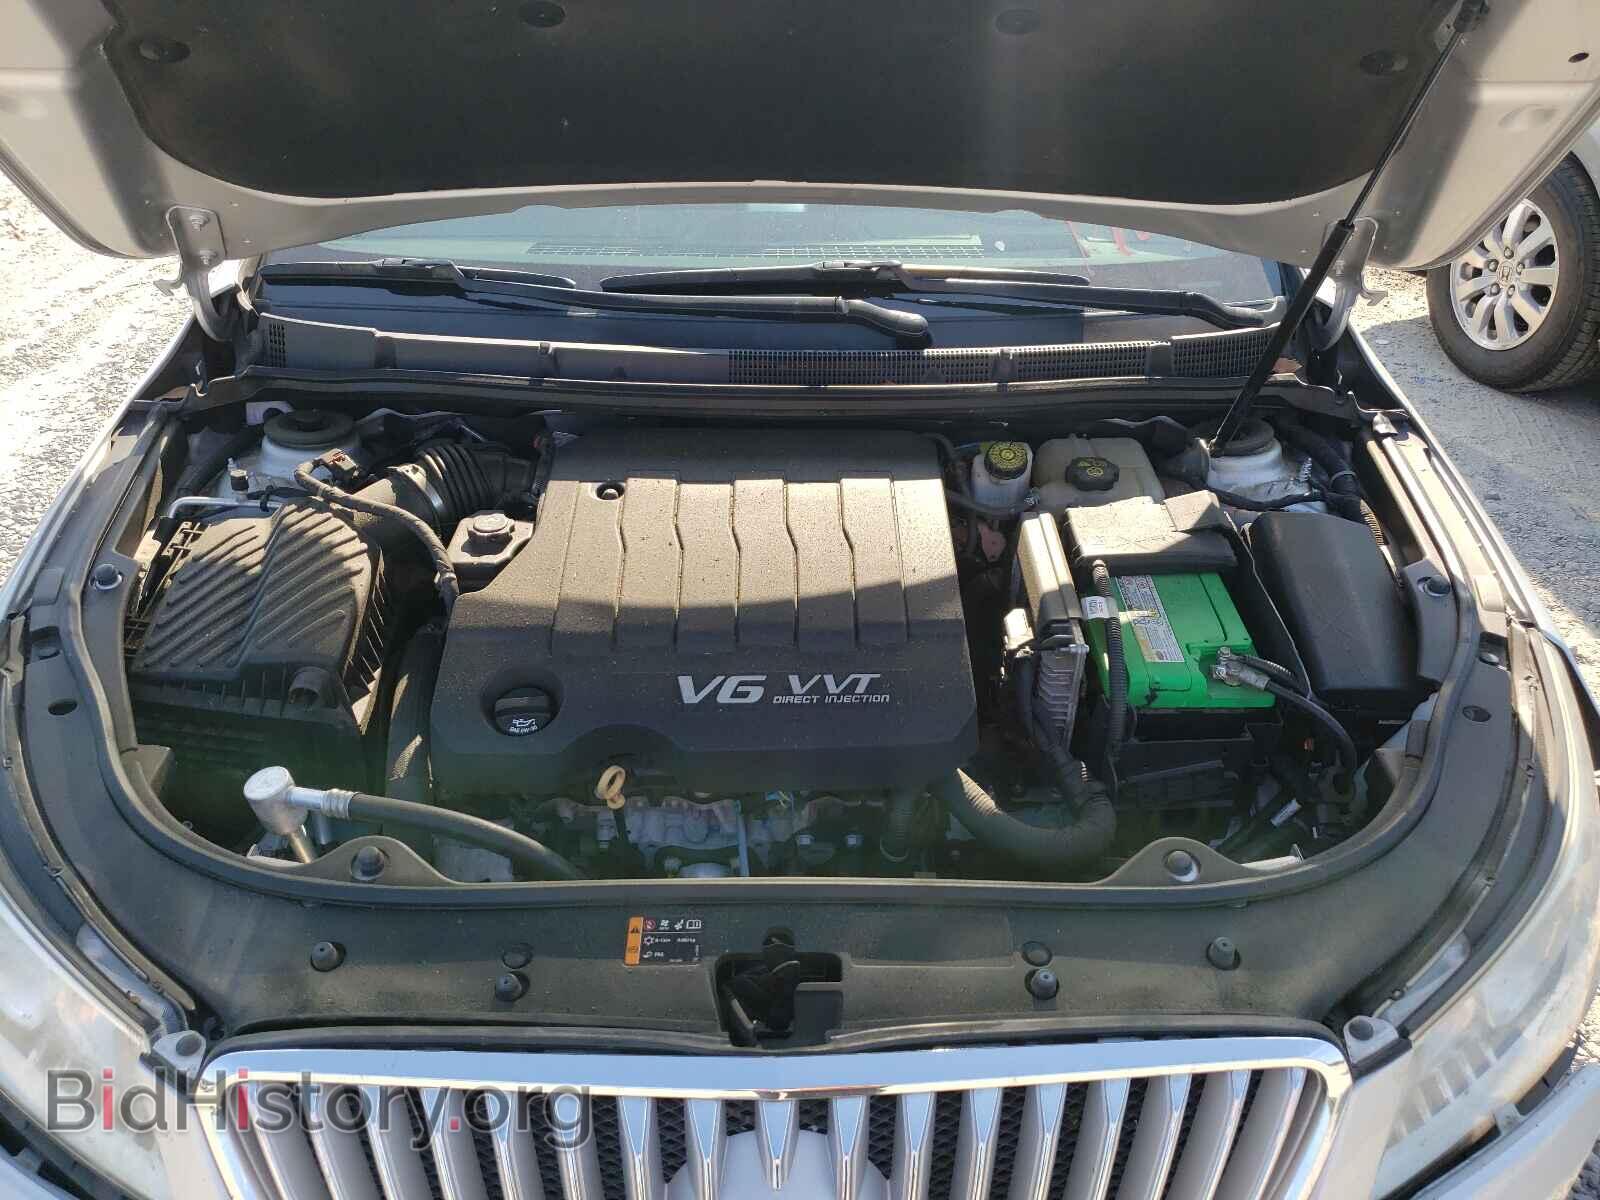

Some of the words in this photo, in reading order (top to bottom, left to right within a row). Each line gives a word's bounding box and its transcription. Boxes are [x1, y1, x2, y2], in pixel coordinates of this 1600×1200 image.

[677, 675, 767, 704] V6
[788, 673, 881, 695] VVT
[773, 695, 821, 704] DIRECT
[824, 694, 890, 704] INJECTION
